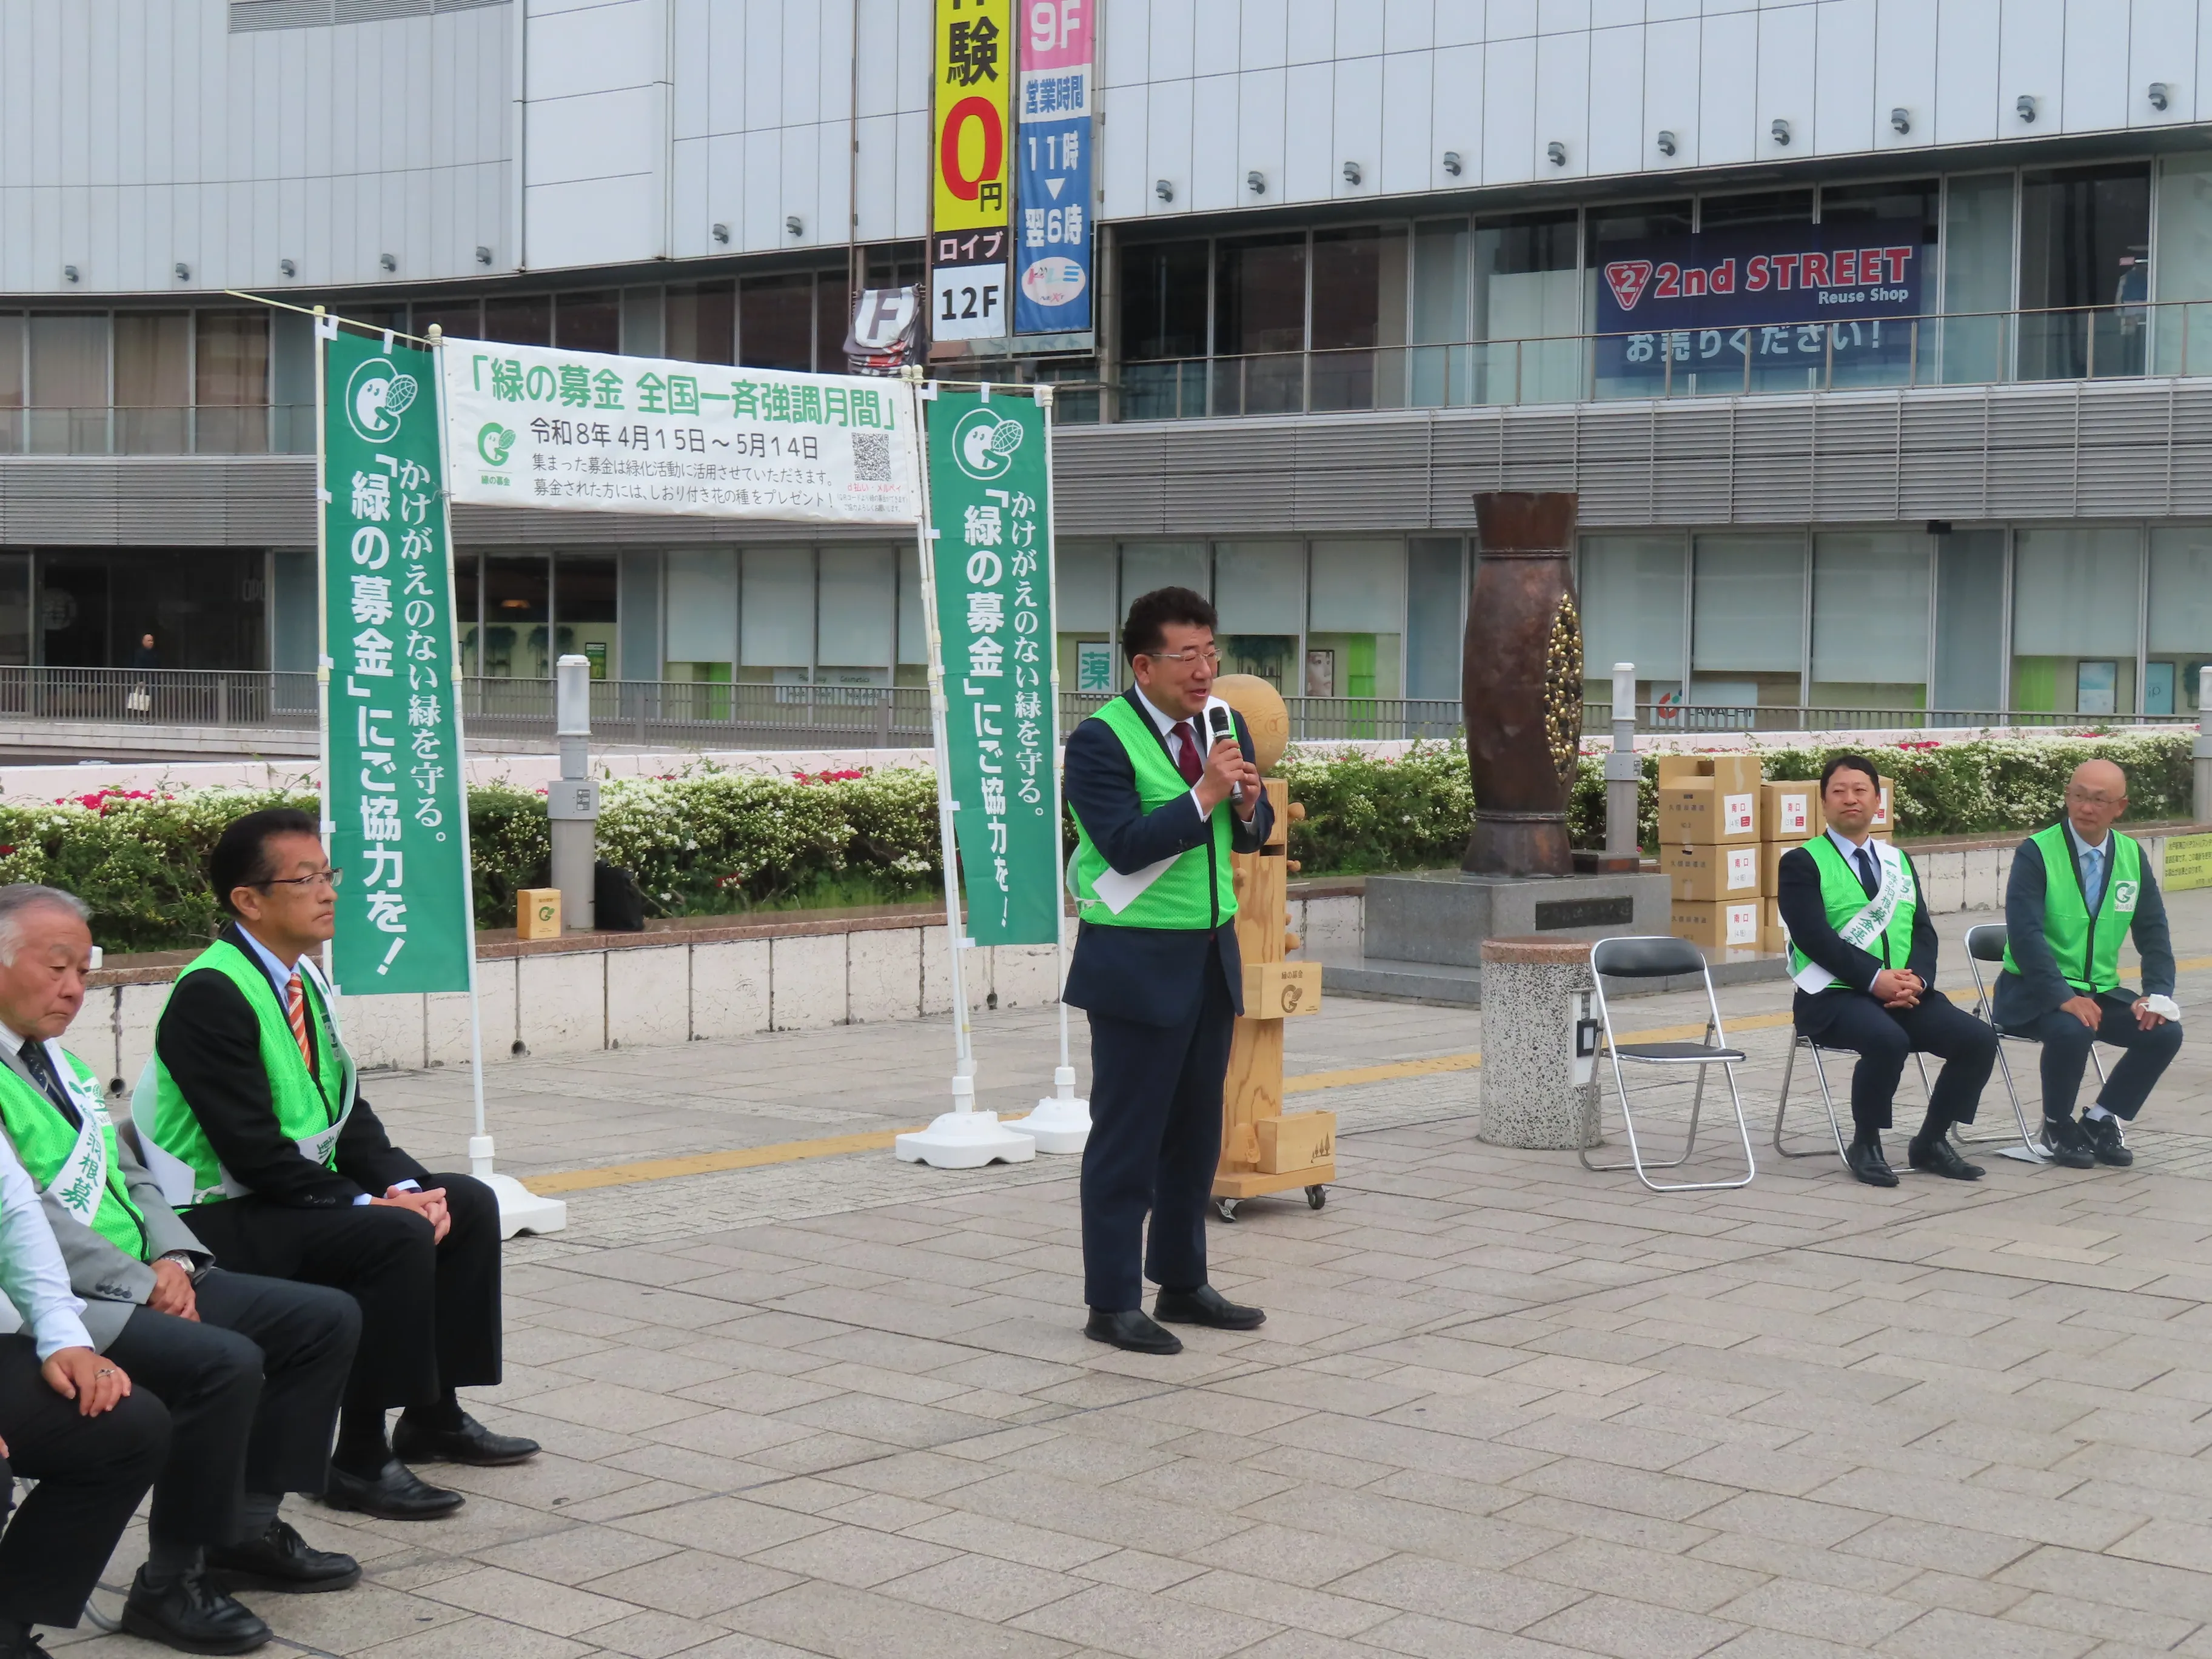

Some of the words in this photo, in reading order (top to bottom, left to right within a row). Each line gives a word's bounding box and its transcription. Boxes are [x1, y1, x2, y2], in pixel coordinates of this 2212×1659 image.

[1031, 1, 1081, 52] 9F
[1025, 73, 1084, 115] 営業時間
[1028, 130, 1079, 172] 11時
[939, 230, 1004, 261] ロイブ
[1025, 203, 1082, 248] 翌6時
[1654, 258, 1736, 299] 2nd
[1744, 246, 1913, 292] STREET
[941, 286, 999, 321] 12F
[1818, 291, 1865, 305] Reuse
[1869, 287, 1909, 304] Shop
[472, 355, 625, 411] 「緑の募金
[636, 372, 896, 431] 全国一斉強調月間」
[481, 474, 511, 487] 緑の募金
[532, 452, 833, 487] 集まった募金は緑化活動に活用させていただきます。
[534, 477, 834, 509] 募金された方には、しおり付き花の種をプレゼント！
[398, 458, 447, 843] かけがえのない緑を守る。
[1011, 491, 1044, 817] かけがえのない緑を守る。
[1081, 651, 1110, 690] 薬
[347, 453, 408, 976] 「緑の募金」にご協力を！
[964, 488, 1008, 929] 「緑の募金」にご協力を！
[1734, 913, 1749, 923] 南口
[1281, 969, 1304, 980] 緑の募金
